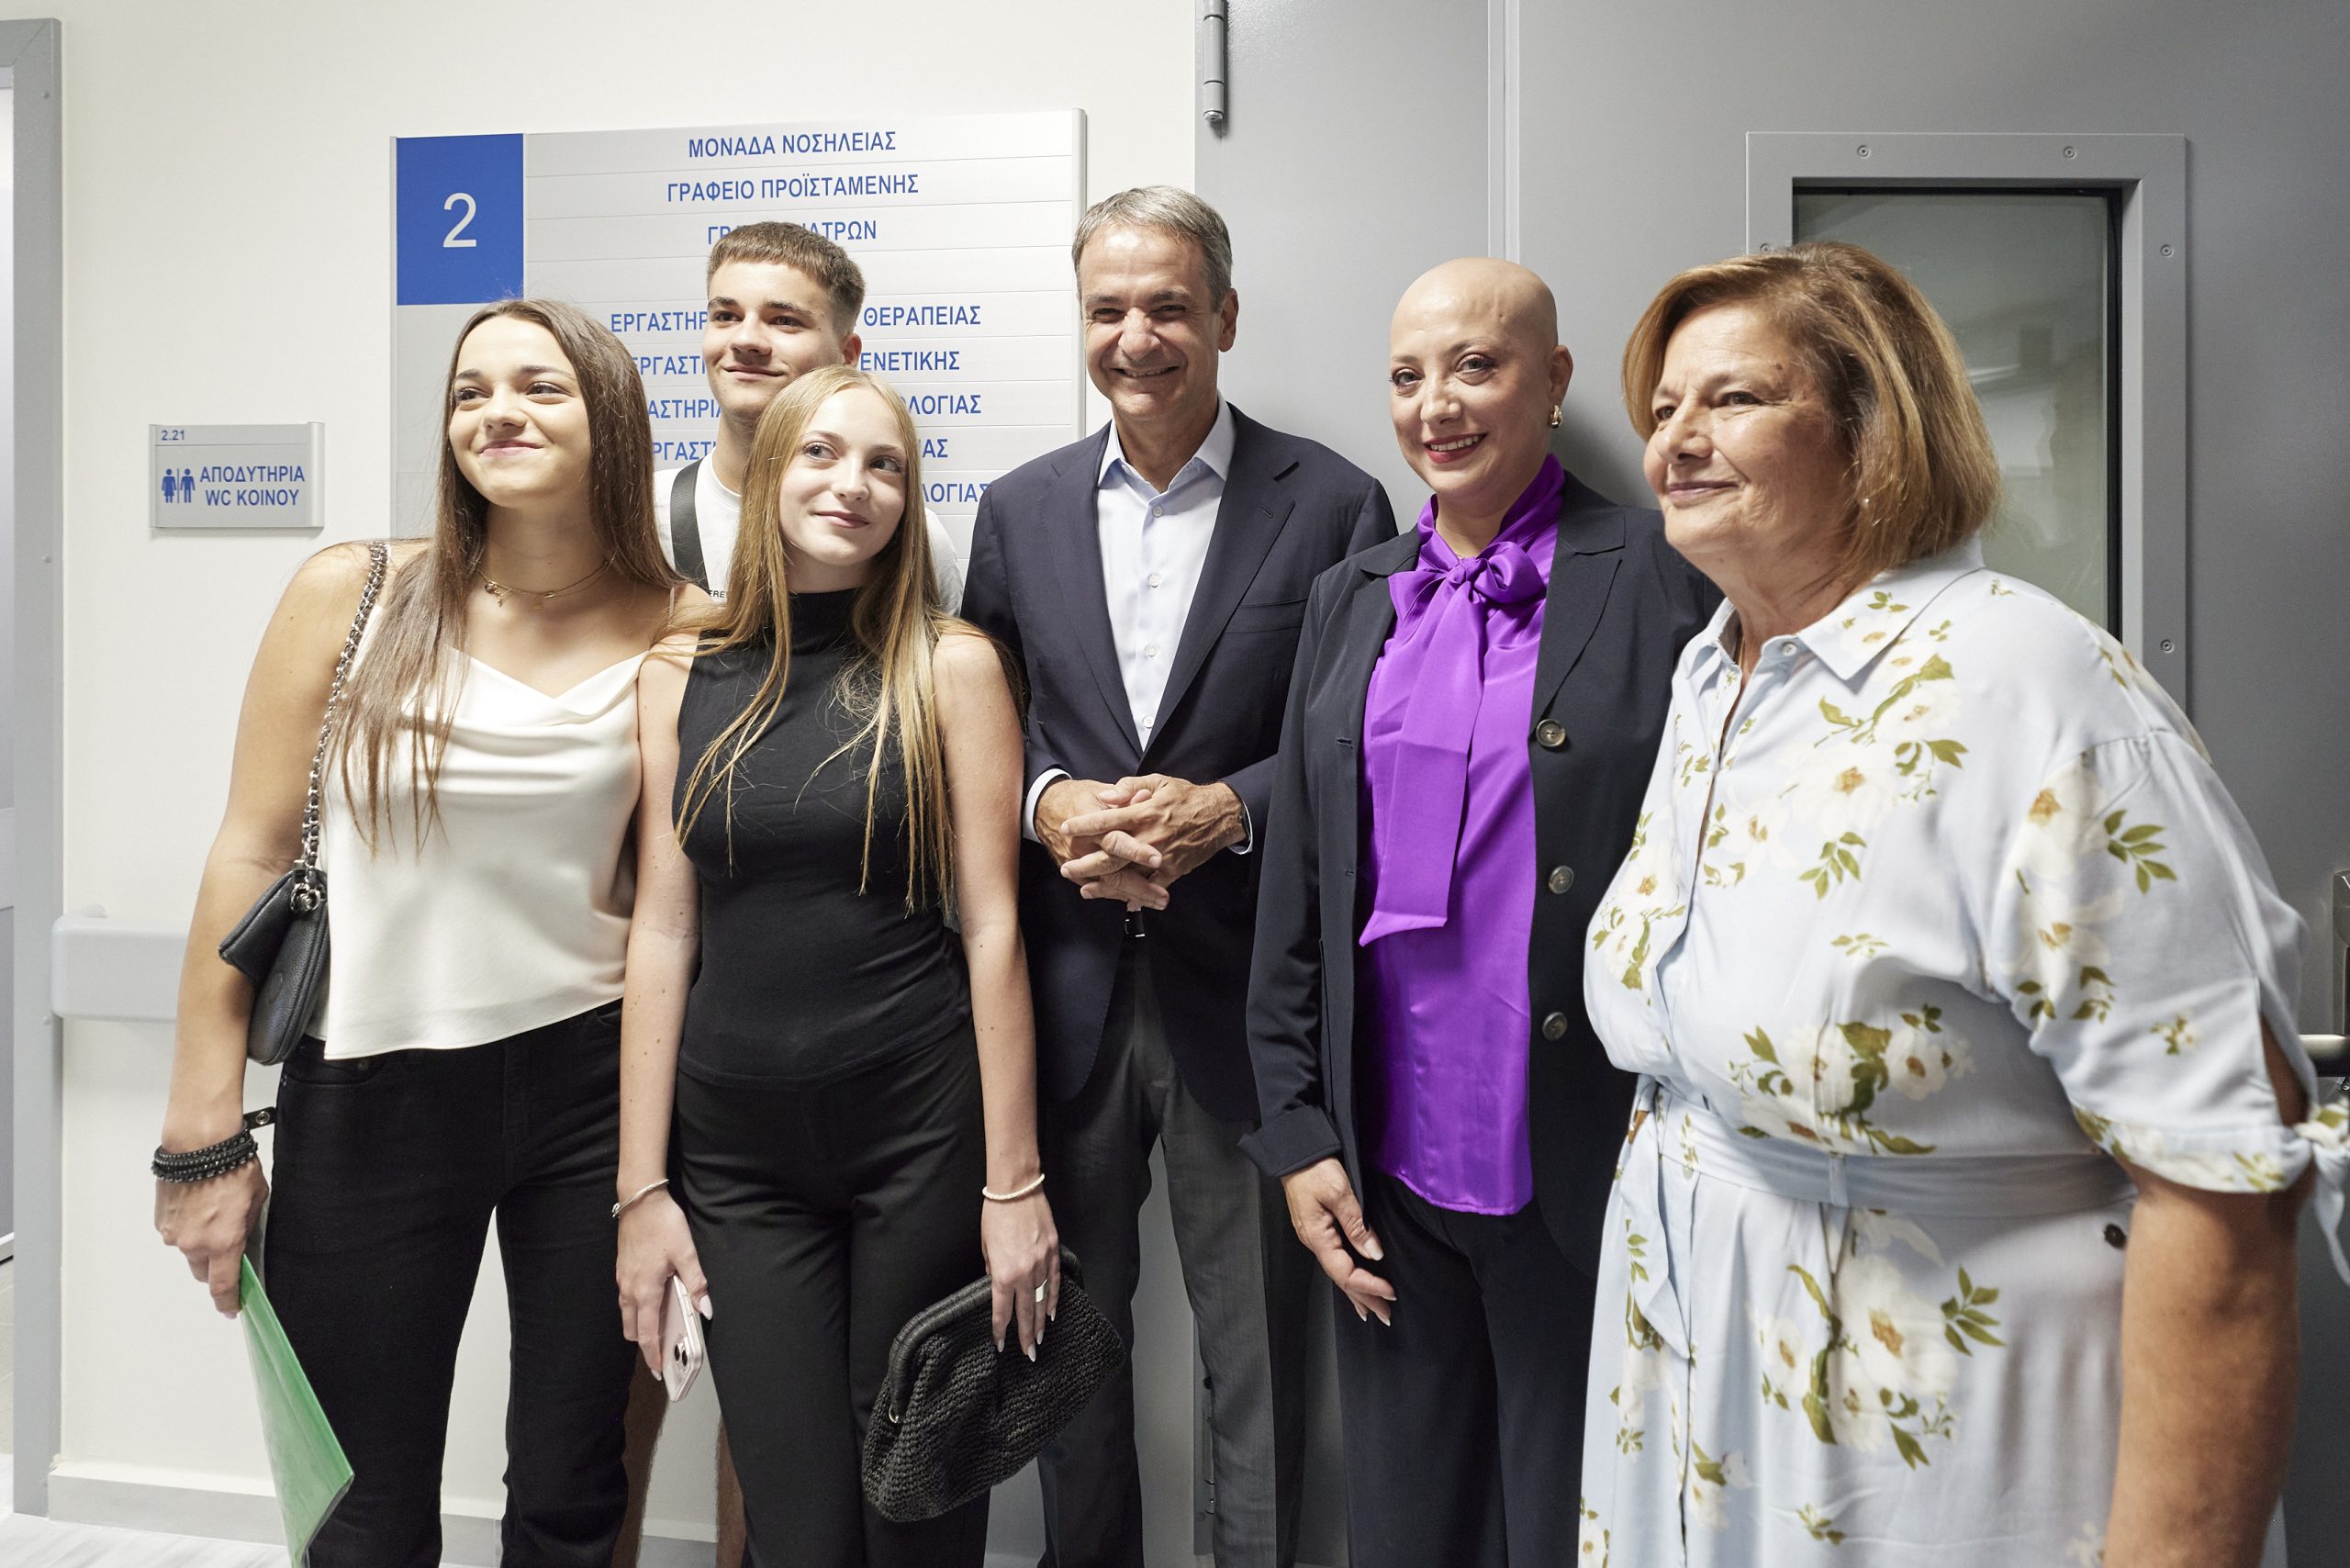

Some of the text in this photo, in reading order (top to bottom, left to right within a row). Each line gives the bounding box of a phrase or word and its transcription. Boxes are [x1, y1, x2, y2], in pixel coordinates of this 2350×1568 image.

[688, 131, 896, 158] ΜΟΝΑΔΑ ΝΟΣΗΛΕΙΑΣ
[667, 174, 919, 202] ΓΡΑΦΕΙΟ ΠΡΟΪΣΤΑΜΕΝΗΣ
[442, 193, 477, 248] 2
[610, 305, 981, 332] ΕΡΓΑΣΤΗΡ ΘΕΡΑΠΕΙΑΣ
[860, 351, 960, 371] ΕΝΕΤΙΚΗΣ
[648, 394, 981, 419] ΑΣΤΗΡΙ ΛΟΓΙΑΣ
[161, 430, 185, 442] 2.21
[653, 441, 716, 461] ΡΓΑΣΤ
[199, 465, 306, 483] ΑΠΟΔΥΤΗΡΙΑ
[205, 488, 300, 506] WC ΚΟΙΝΟΥ
